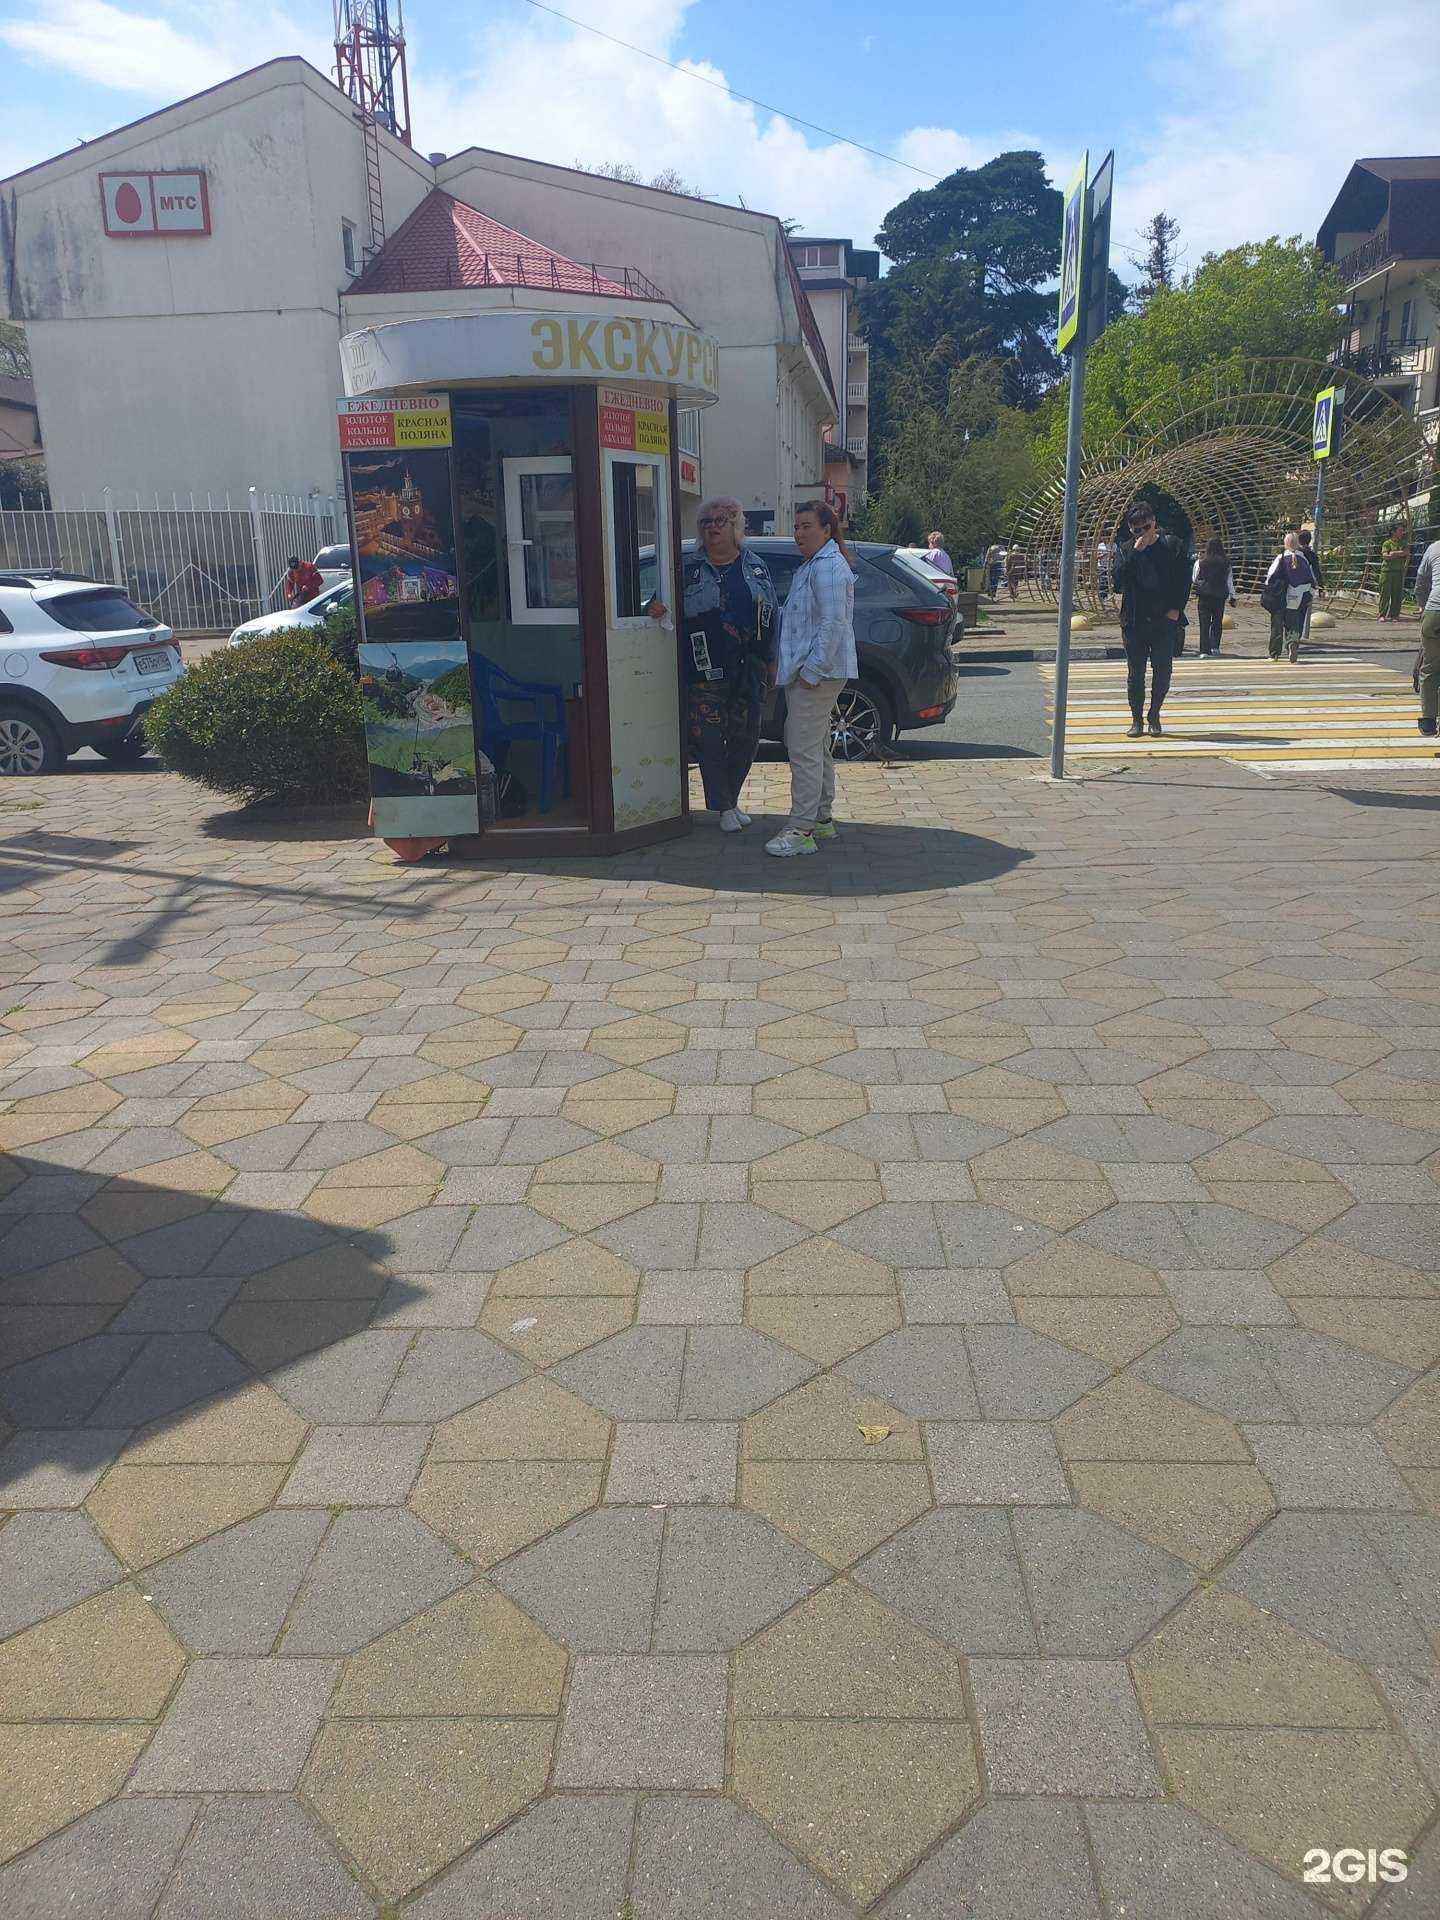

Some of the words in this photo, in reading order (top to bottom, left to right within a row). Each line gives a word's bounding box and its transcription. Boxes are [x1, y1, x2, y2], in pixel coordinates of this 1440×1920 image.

[159, 196, 197, 210] МТС
[346, 398, 440, 413] ЕЖЕДНЕВНО
[603, 390, 664, 413] ЕЖЕДНЕВНО
[344, 415, 389, 425] ЗОЛОТОЕ
[398, 417, 448, 428] КРАСНАЯ
[347, 426, 387, 436] КОЛЬЦО
[638, 421, 668, 434] КРАСНАЯ
[400, 430, 447, 440] ПОЛЯНА
[346, 437, 389, 447] АБХАЗИИ
